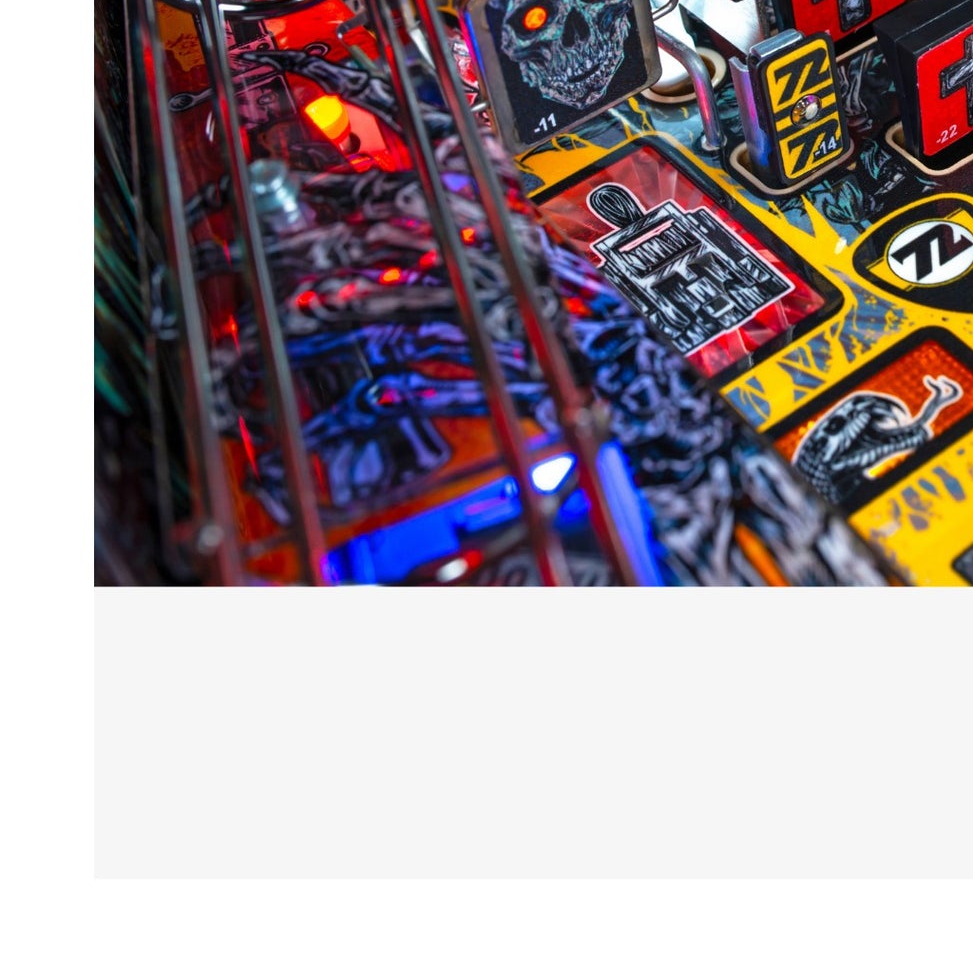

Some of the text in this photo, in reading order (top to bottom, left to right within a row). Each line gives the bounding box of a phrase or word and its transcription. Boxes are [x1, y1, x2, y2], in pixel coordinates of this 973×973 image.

[533, 113, 557, 133] -11
[936, 124, 957, 144] -22
[814, 136, 837, 157] -14
[890, 223, 973, 281] 72
